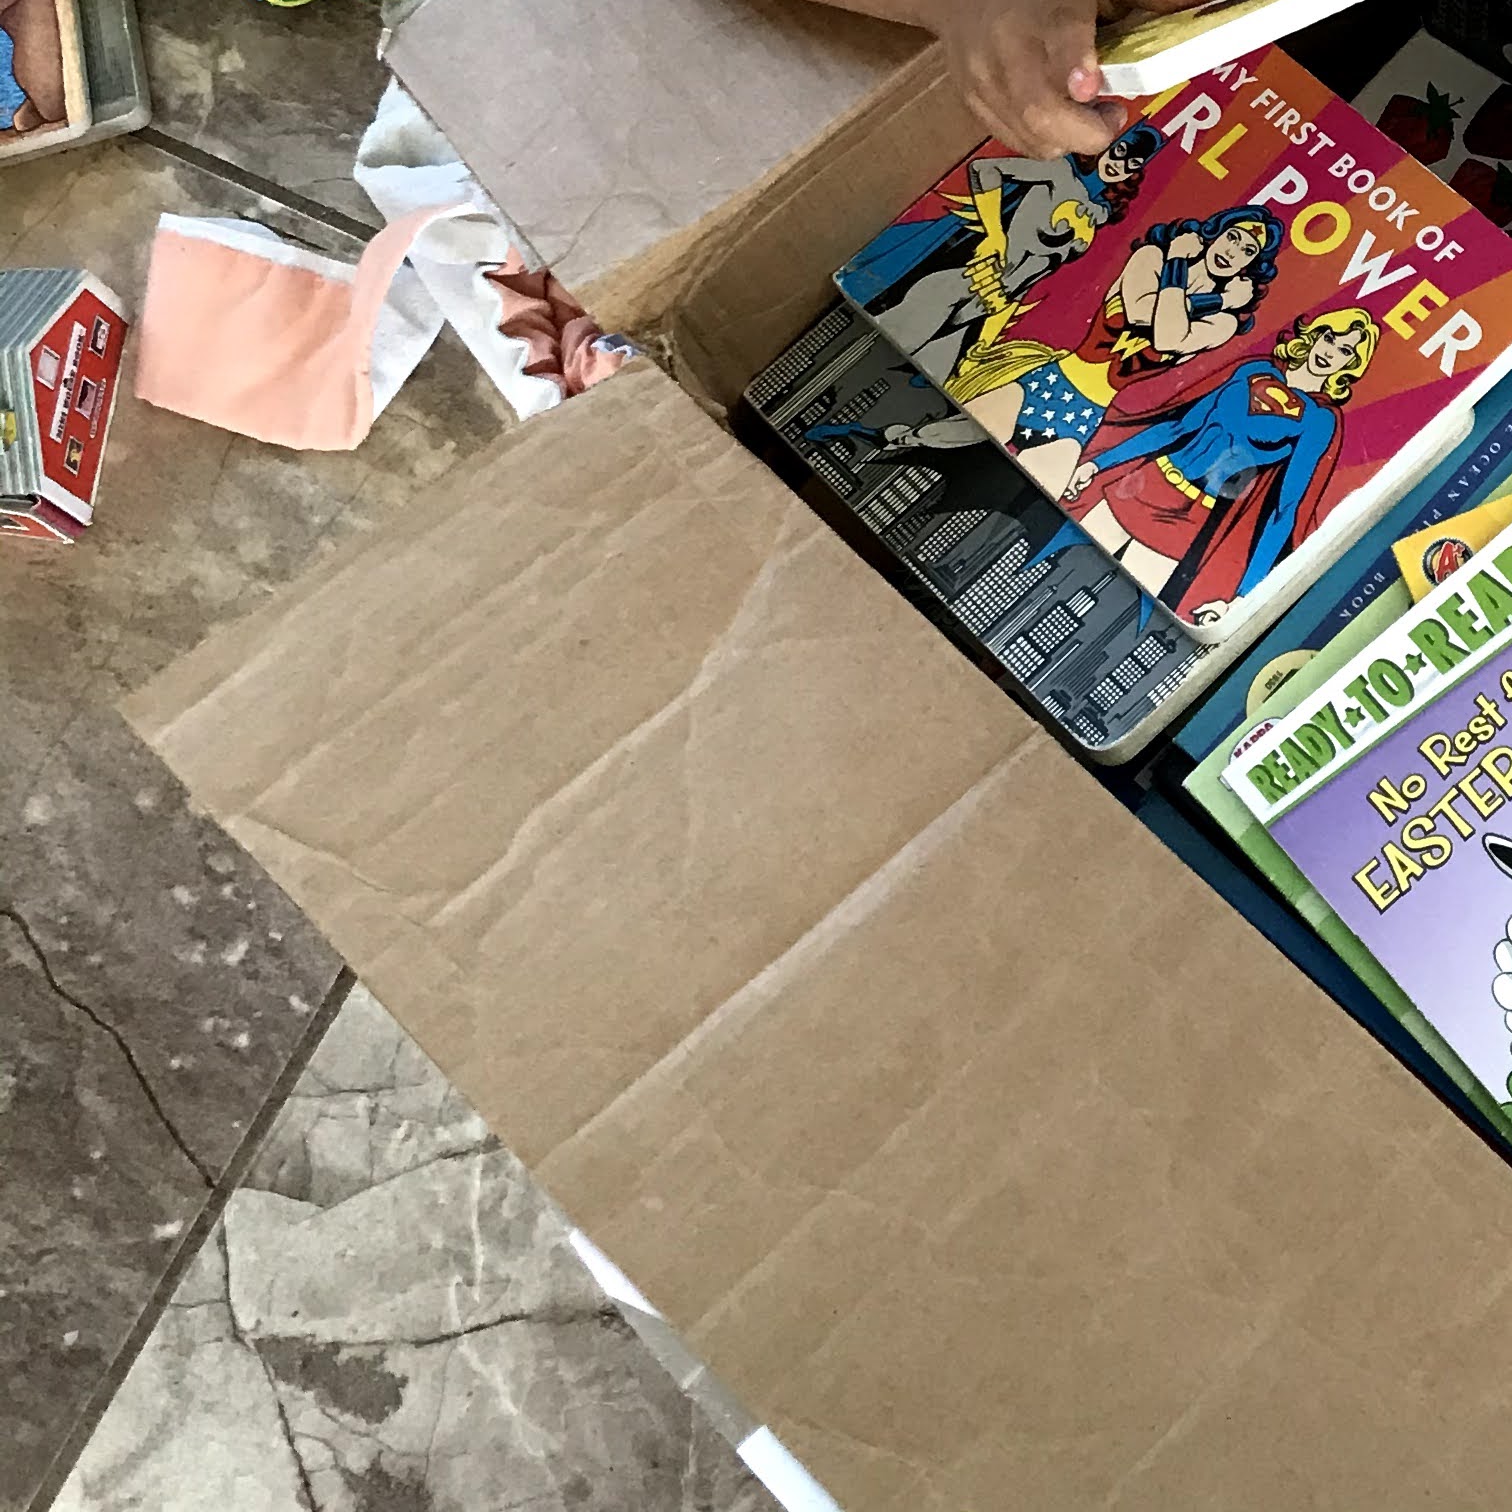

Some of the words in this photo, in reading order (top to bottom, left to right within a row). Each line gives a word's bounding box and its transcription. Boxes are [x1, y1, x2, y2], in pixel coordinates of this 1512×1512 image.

[1140, 79, 1248, 181] IRL
[1247, 164, 1482, 378] POWER
[1212, 62, 1258, 91] MY
[1249, 88, 1336, 157] FIRST
[1327, 152, 1420, 231] BOOK
[1415, 225, 1465, 263] OF
[1448, 442, 1500, 501] OCEAN
[1339, 572, 1386, 619] BOOK
[1246, 701, 1356, 805] READY
[1343, 658, 1416, 724] TO
[1366, 773, 1428, 827] No
[1418, 693, 1508, 780] Rest
